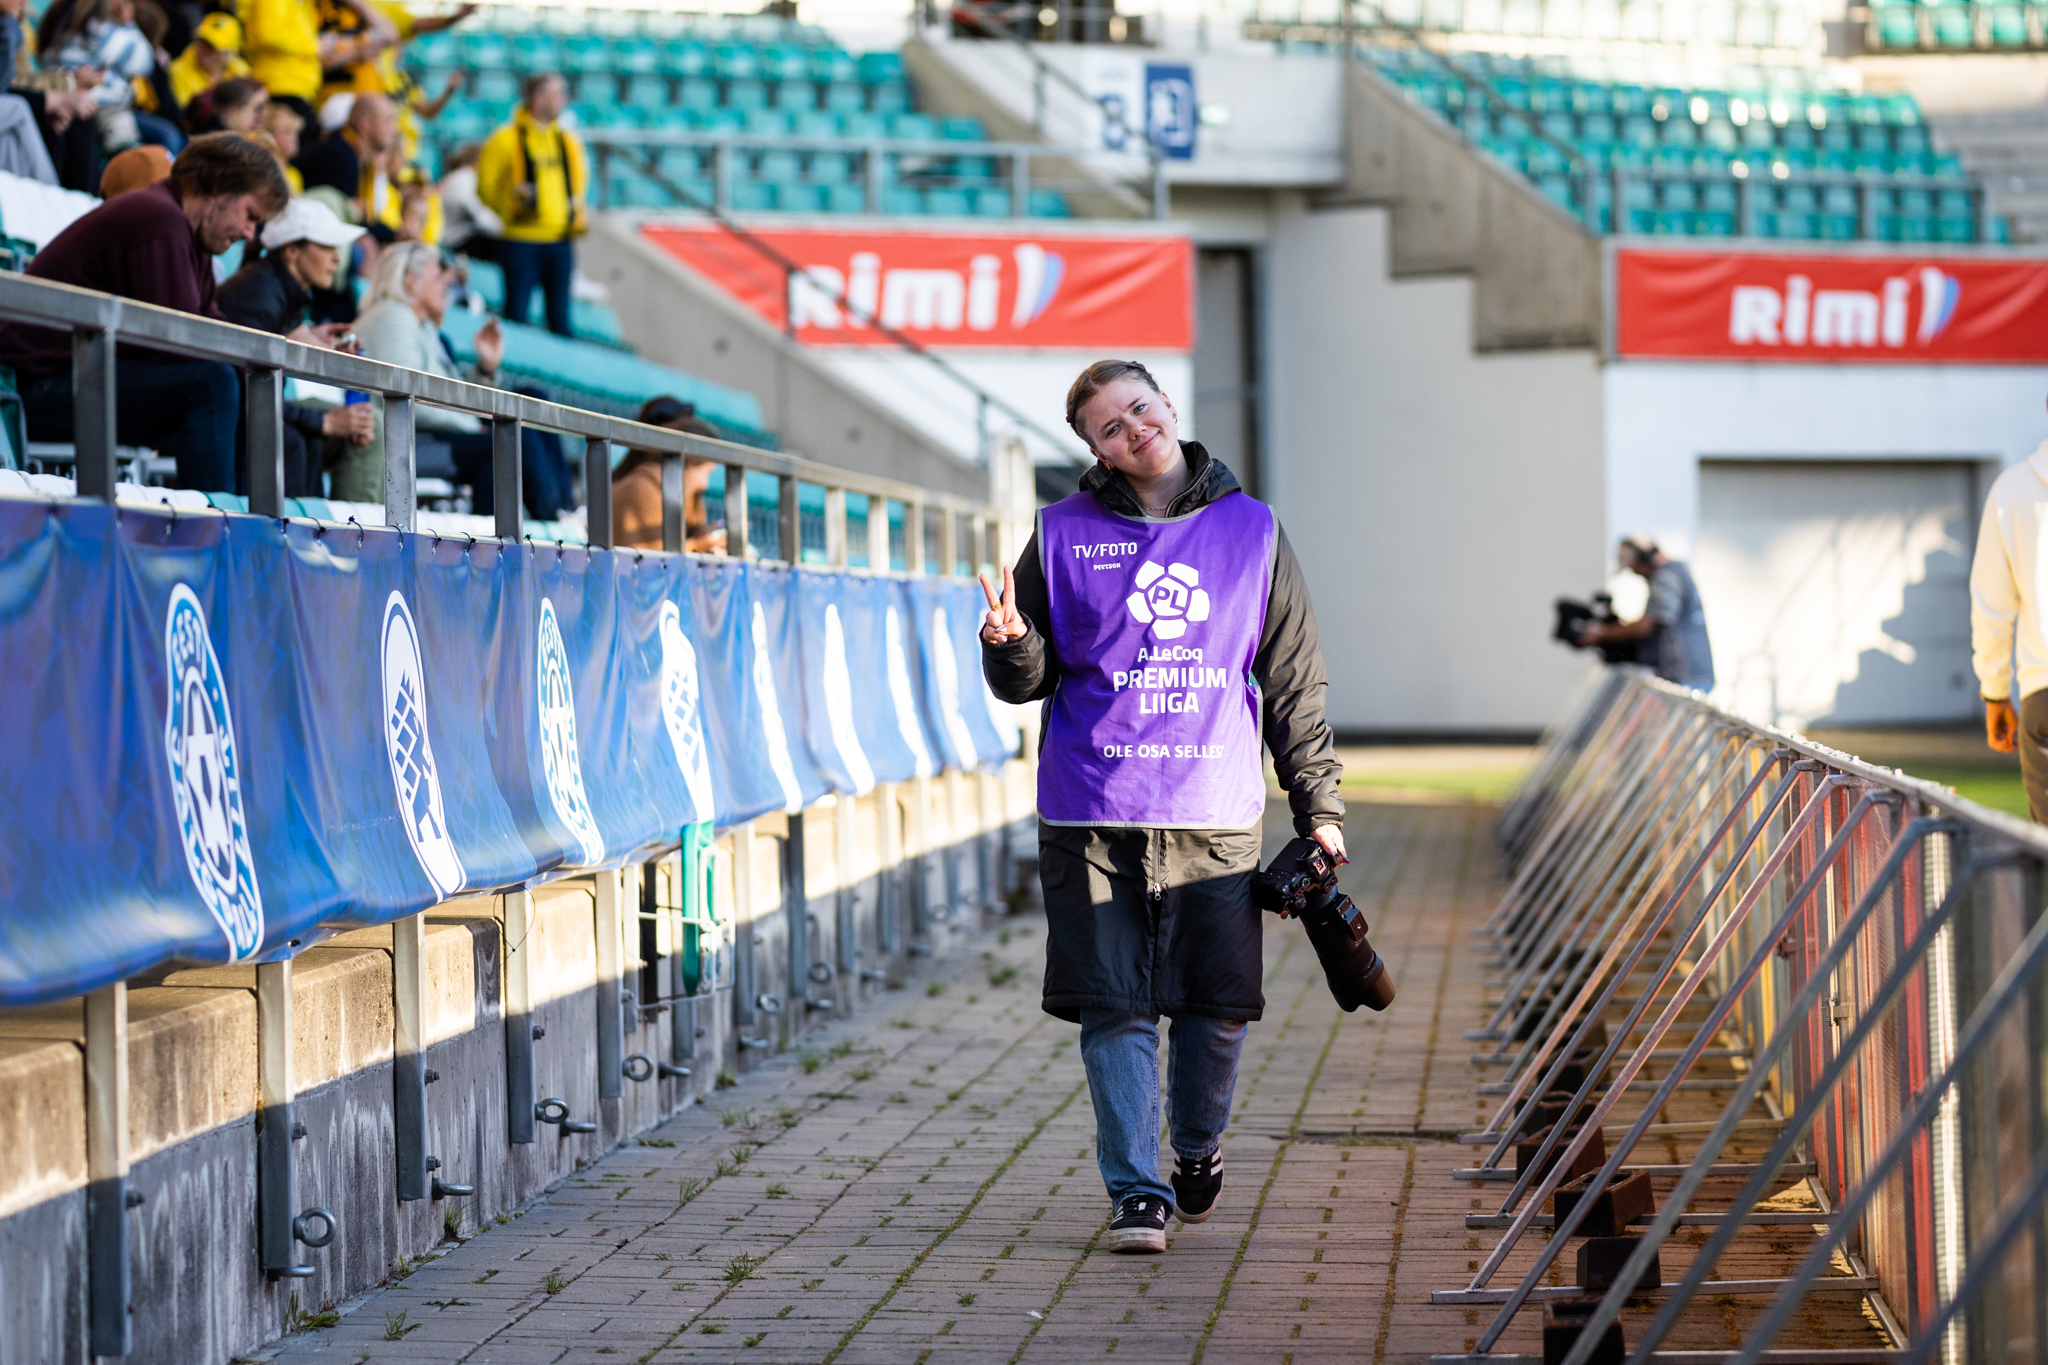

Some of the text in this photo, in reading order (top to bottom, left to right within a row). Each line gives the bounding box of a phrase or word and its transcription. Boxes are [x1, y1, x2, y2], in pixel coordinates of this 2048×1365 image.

[789, 252, 1001, 330] Rimi
[1728, 273, 1911, 348] Rimi
[1072, 542, 1138, 559] TV/FOTO
[1151, 585, 1187, 612] PL
[1137, 645, 1203, 665] A.LeCoq
[1113, 667, 1227, 692] PREMIUM
[1140, 692, 1200, 714] LIIGA
[1103, 744, 1134, 759] OLE
[1137, 744, 1171, 759] OSA
